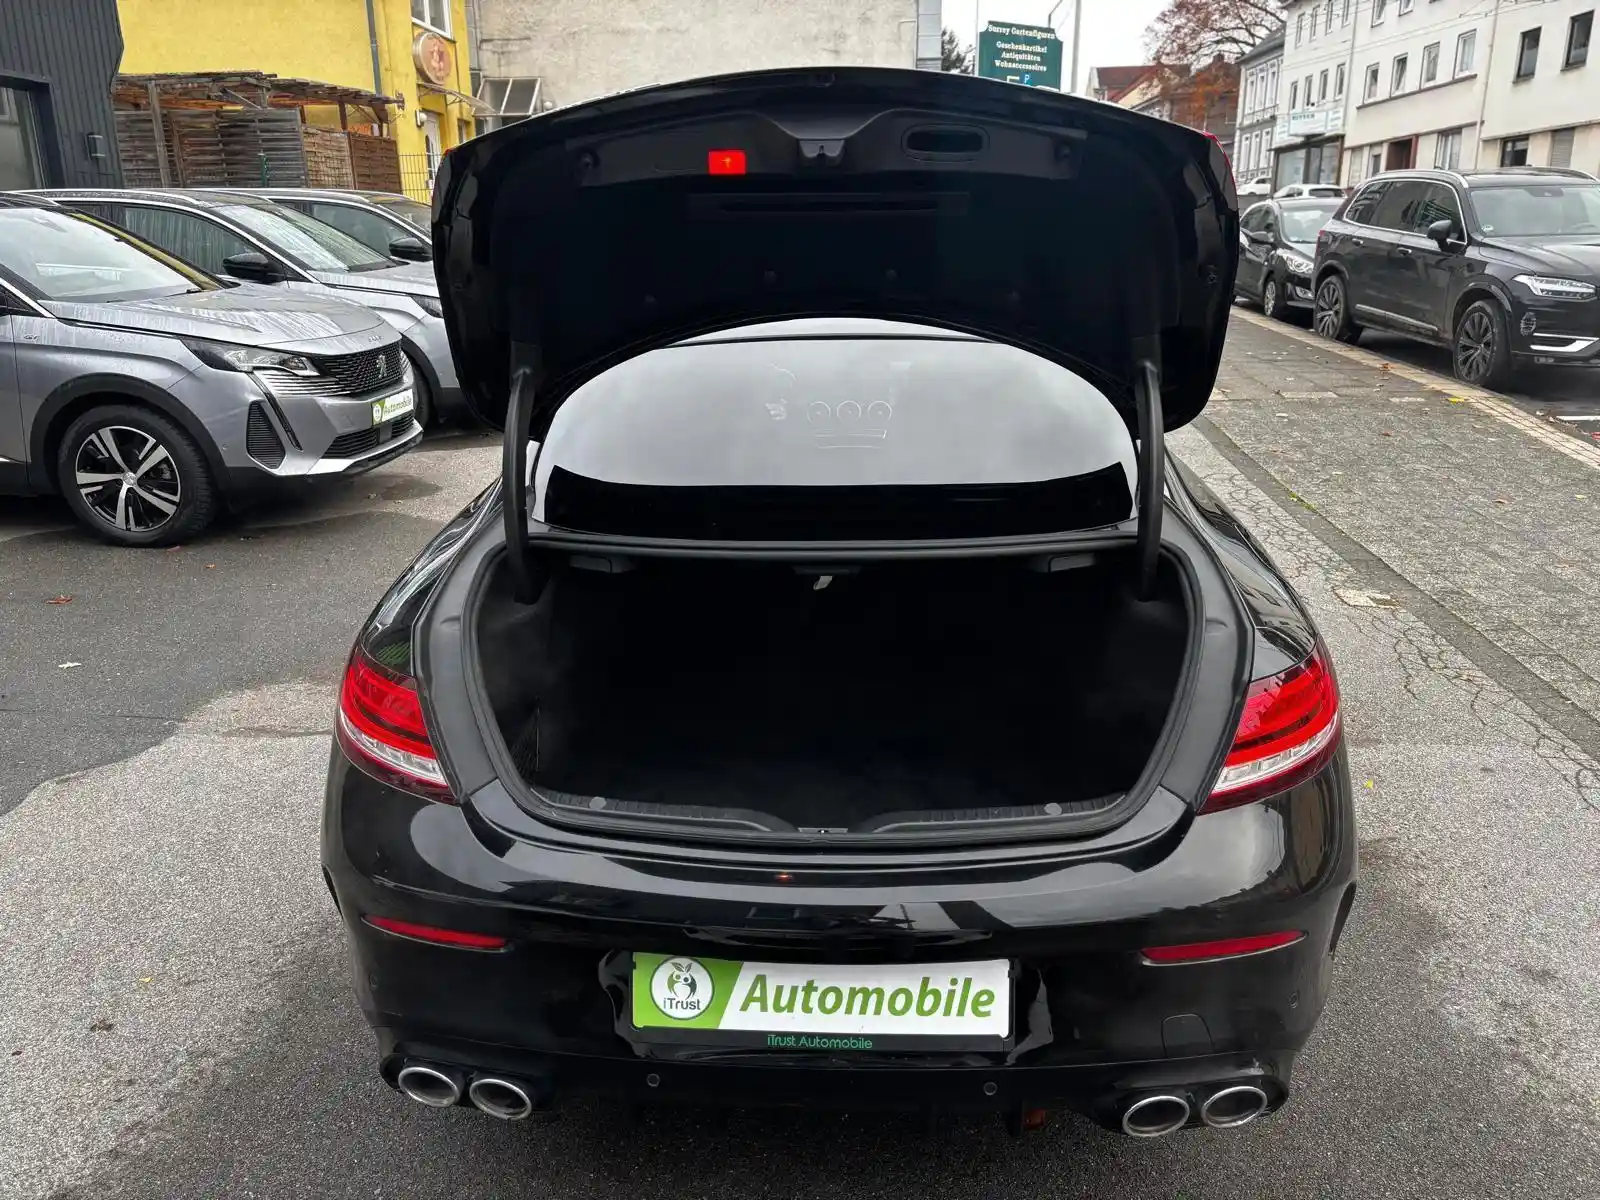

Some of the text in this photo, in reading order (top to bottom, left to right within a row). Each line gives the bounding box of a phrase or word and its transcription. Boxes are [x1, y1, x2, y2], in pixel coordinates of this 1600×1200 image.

[1011, 27, 1056, 40] Gartenfiguren
[996, 41, 1048, 53] Geschenkartikel
[1001, 51, 1041, 62] Antiquitäten
[994, 59, 1047, 72] Wohnaccessoires
[1024, 74, 1031, 84] P
[739, 974, 996, 1018] Automobile
[662, 997, 701, 1012] iTrust
[767, 1034, 873, 1050] iTrust Automobile
